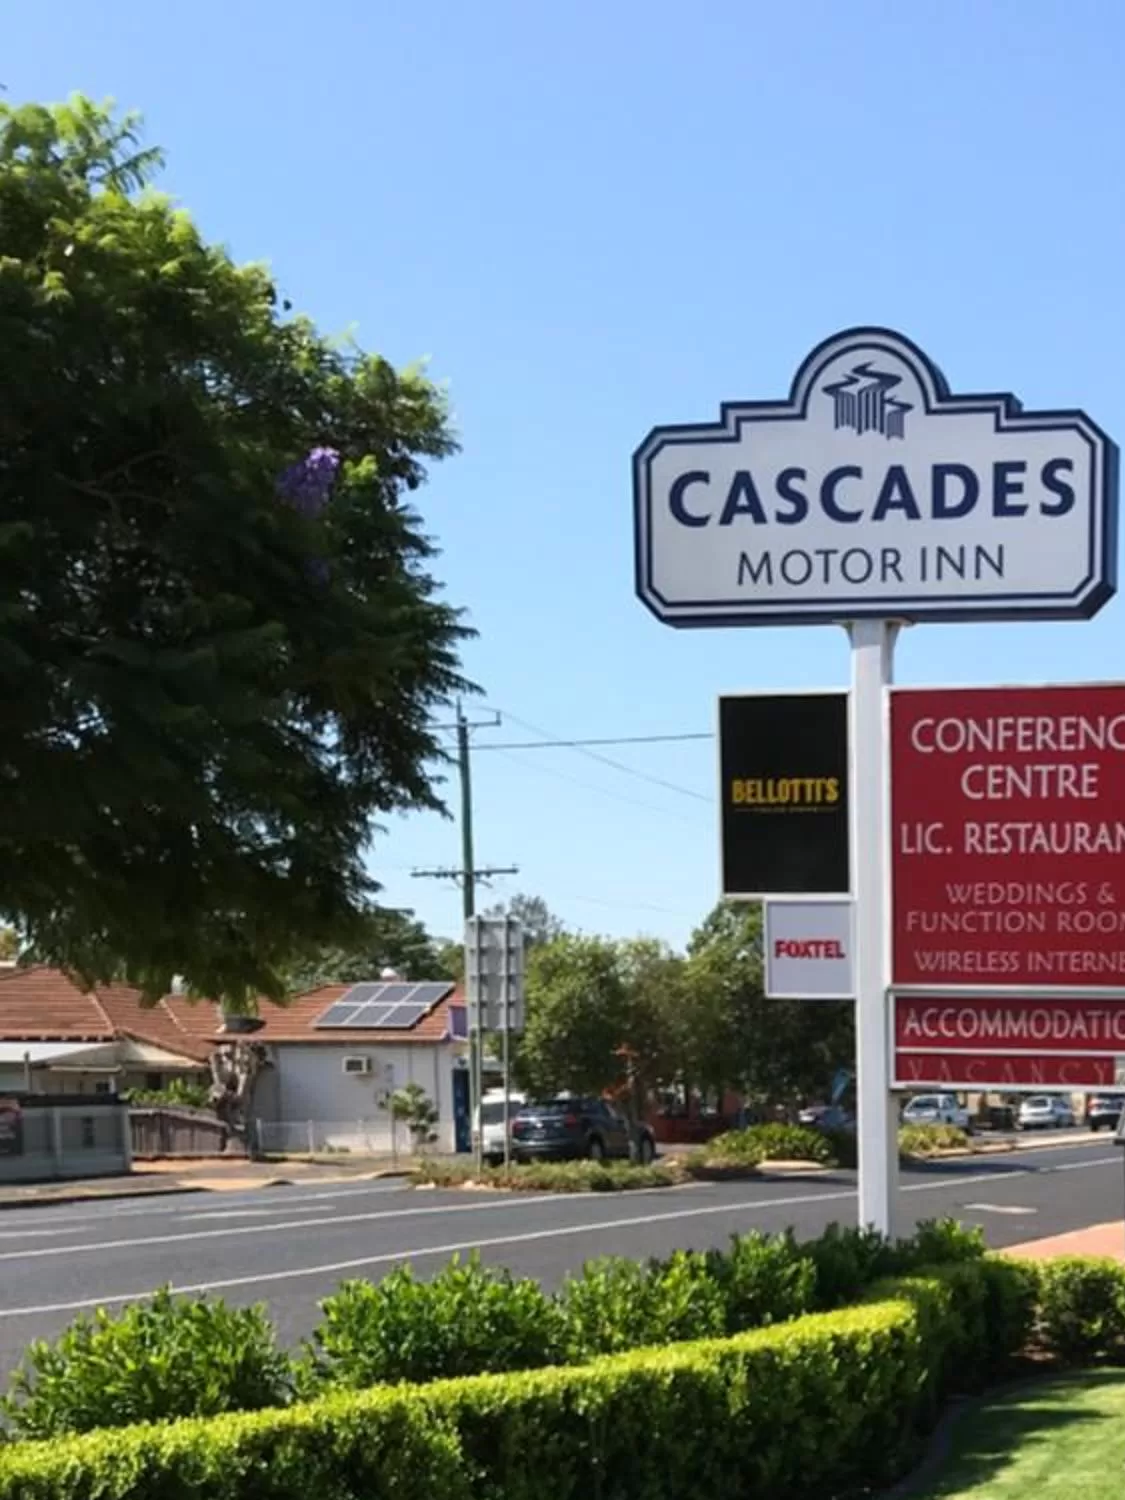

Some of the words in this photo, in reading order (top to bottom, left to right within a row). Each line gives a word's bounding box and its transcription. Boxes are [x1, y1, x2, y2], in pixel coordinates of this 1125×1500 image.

[668, 458, 1076, 528] CASCADES
[737, 548, 904, 585] MOTOR
[920, 544, 1005, 582] INN
[961, 763, 1100, 800] CENTRE
[901, 822, 952, 855] LIC.
[945, 882, 1087, 905] WEDDINGS
[1097, 882, 1115, 903] &
[906, 911, 1045, 933] FUNCTION
[774, 939, 845, 960] FOXTEL
[914, 951, 1020, 973] WIRELESS
[908, 1058, 1108, 1084] VACANCY
